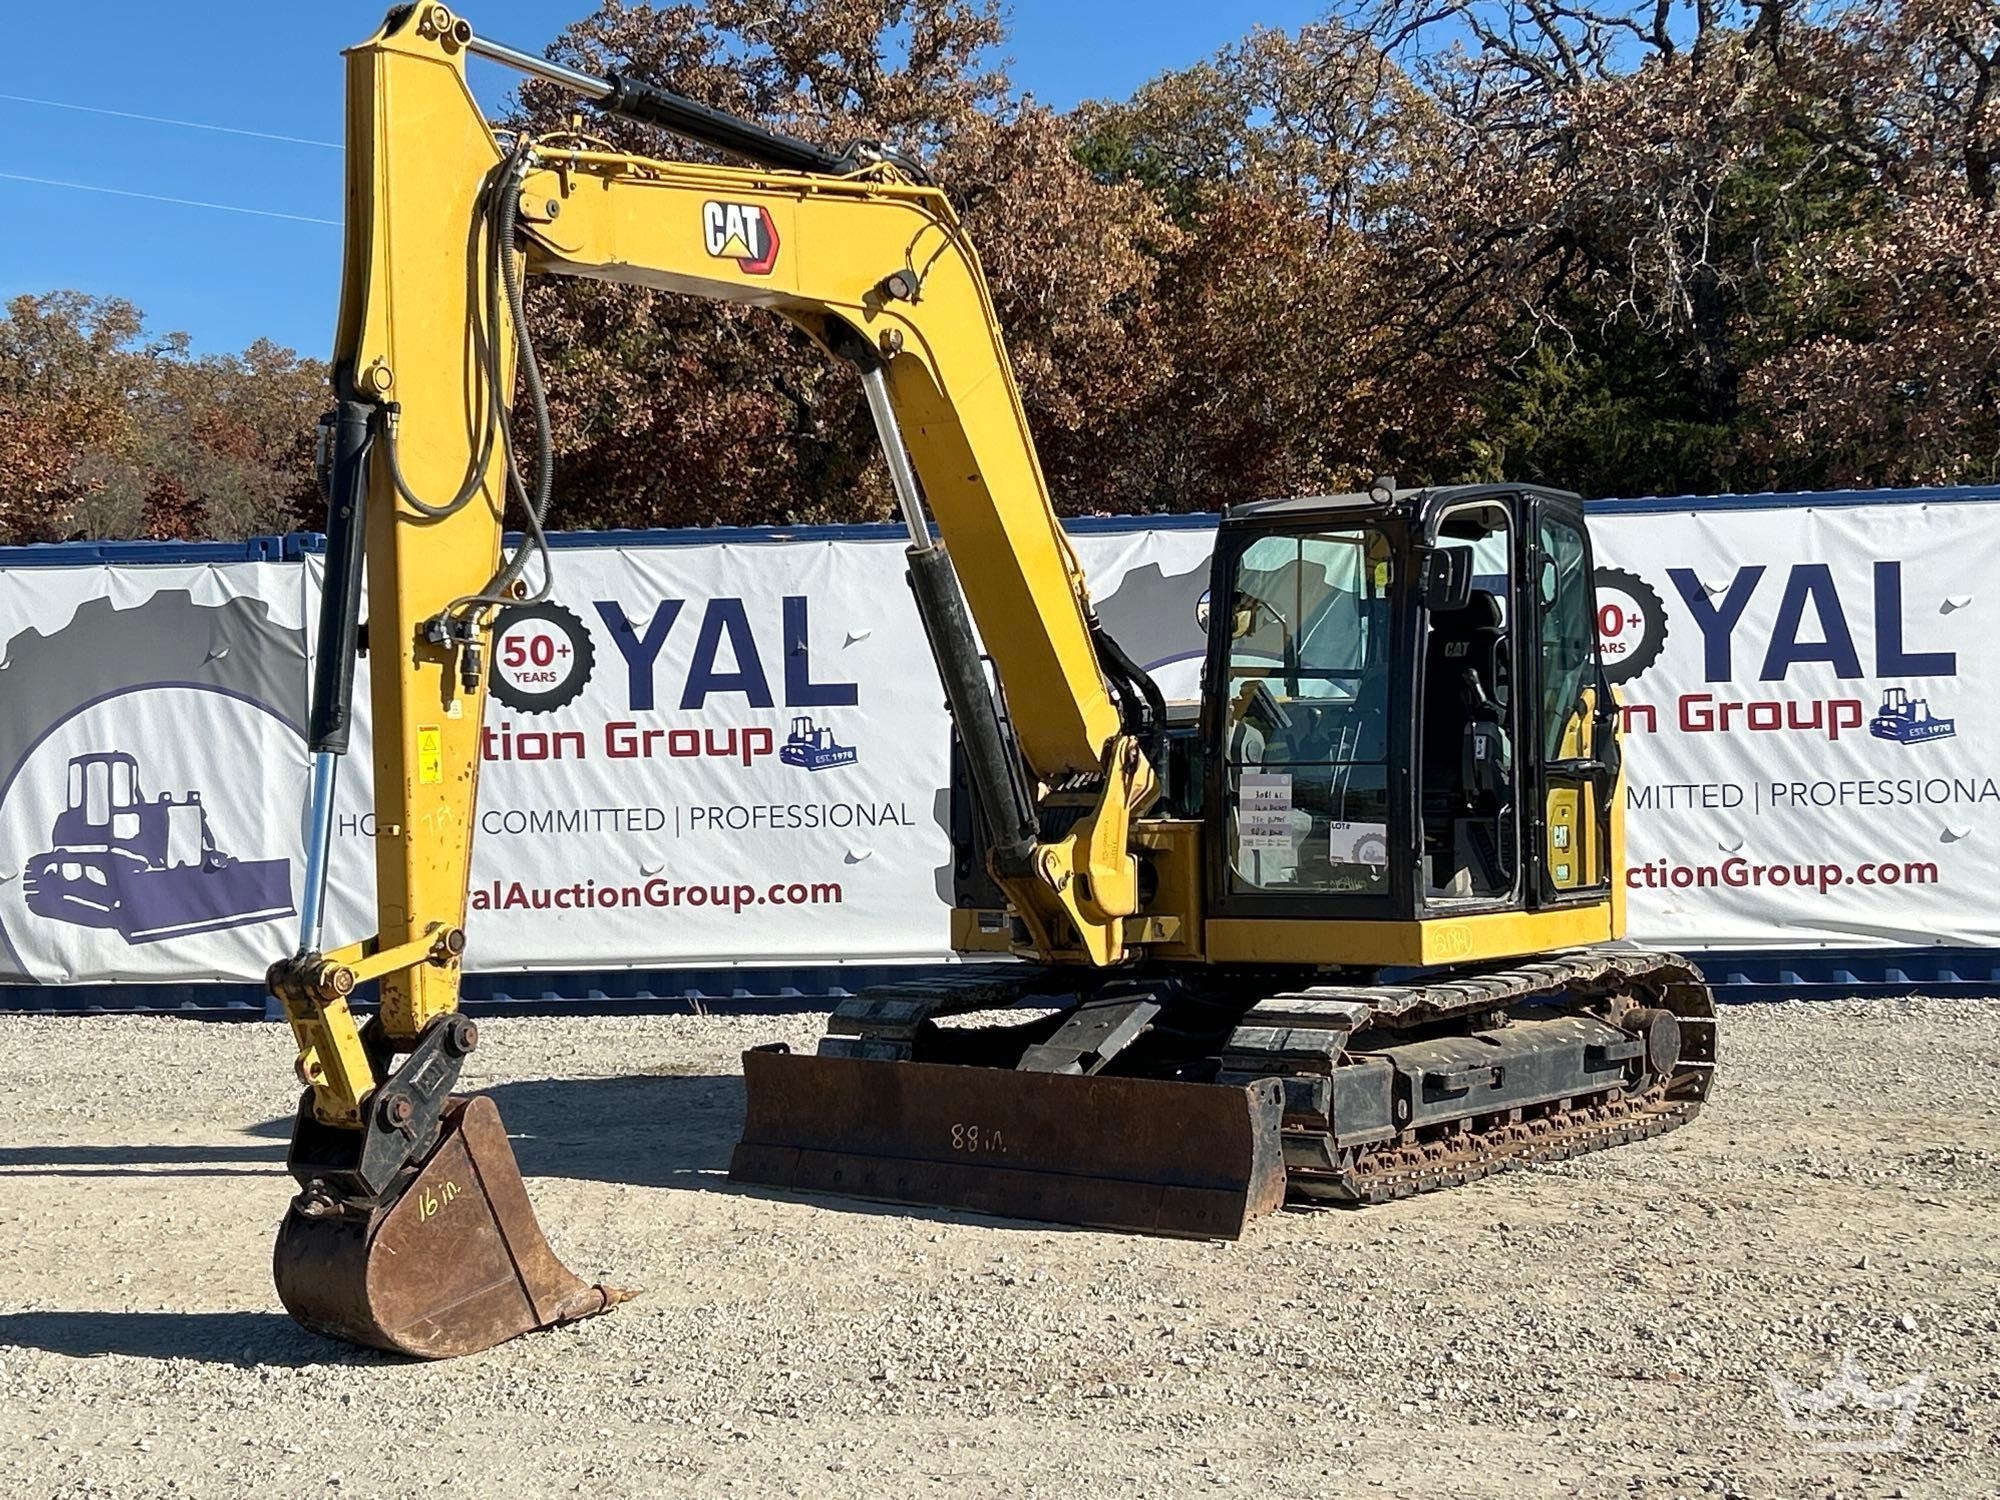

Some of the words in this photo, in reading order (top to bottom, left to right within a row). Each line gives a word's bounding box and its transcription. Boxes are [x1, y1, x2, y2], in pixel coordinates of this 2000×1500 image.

[703, 201, 761, 259] CAT
[503, 635, 571, 667] 50+
[1445, 642, 1470, 657] CAT
[513, 671, 557, 684] YEARS
[1679, 694, 1862, 740] Group
[605, 722, 774, 766] Group
[1627, 784, 1743, 810] MITTED
[482, 807, 665, 835] COMMITTED
[690, 802, 916, 831] PROFESSIONAL
[1626, 857, 1939, 893] ctionGroup.com
[469, 879, 843, 914] alAuctionGroup.com
[951, 1123, 979, 1153] 88
[418, 1187, 438, 1223] 16
